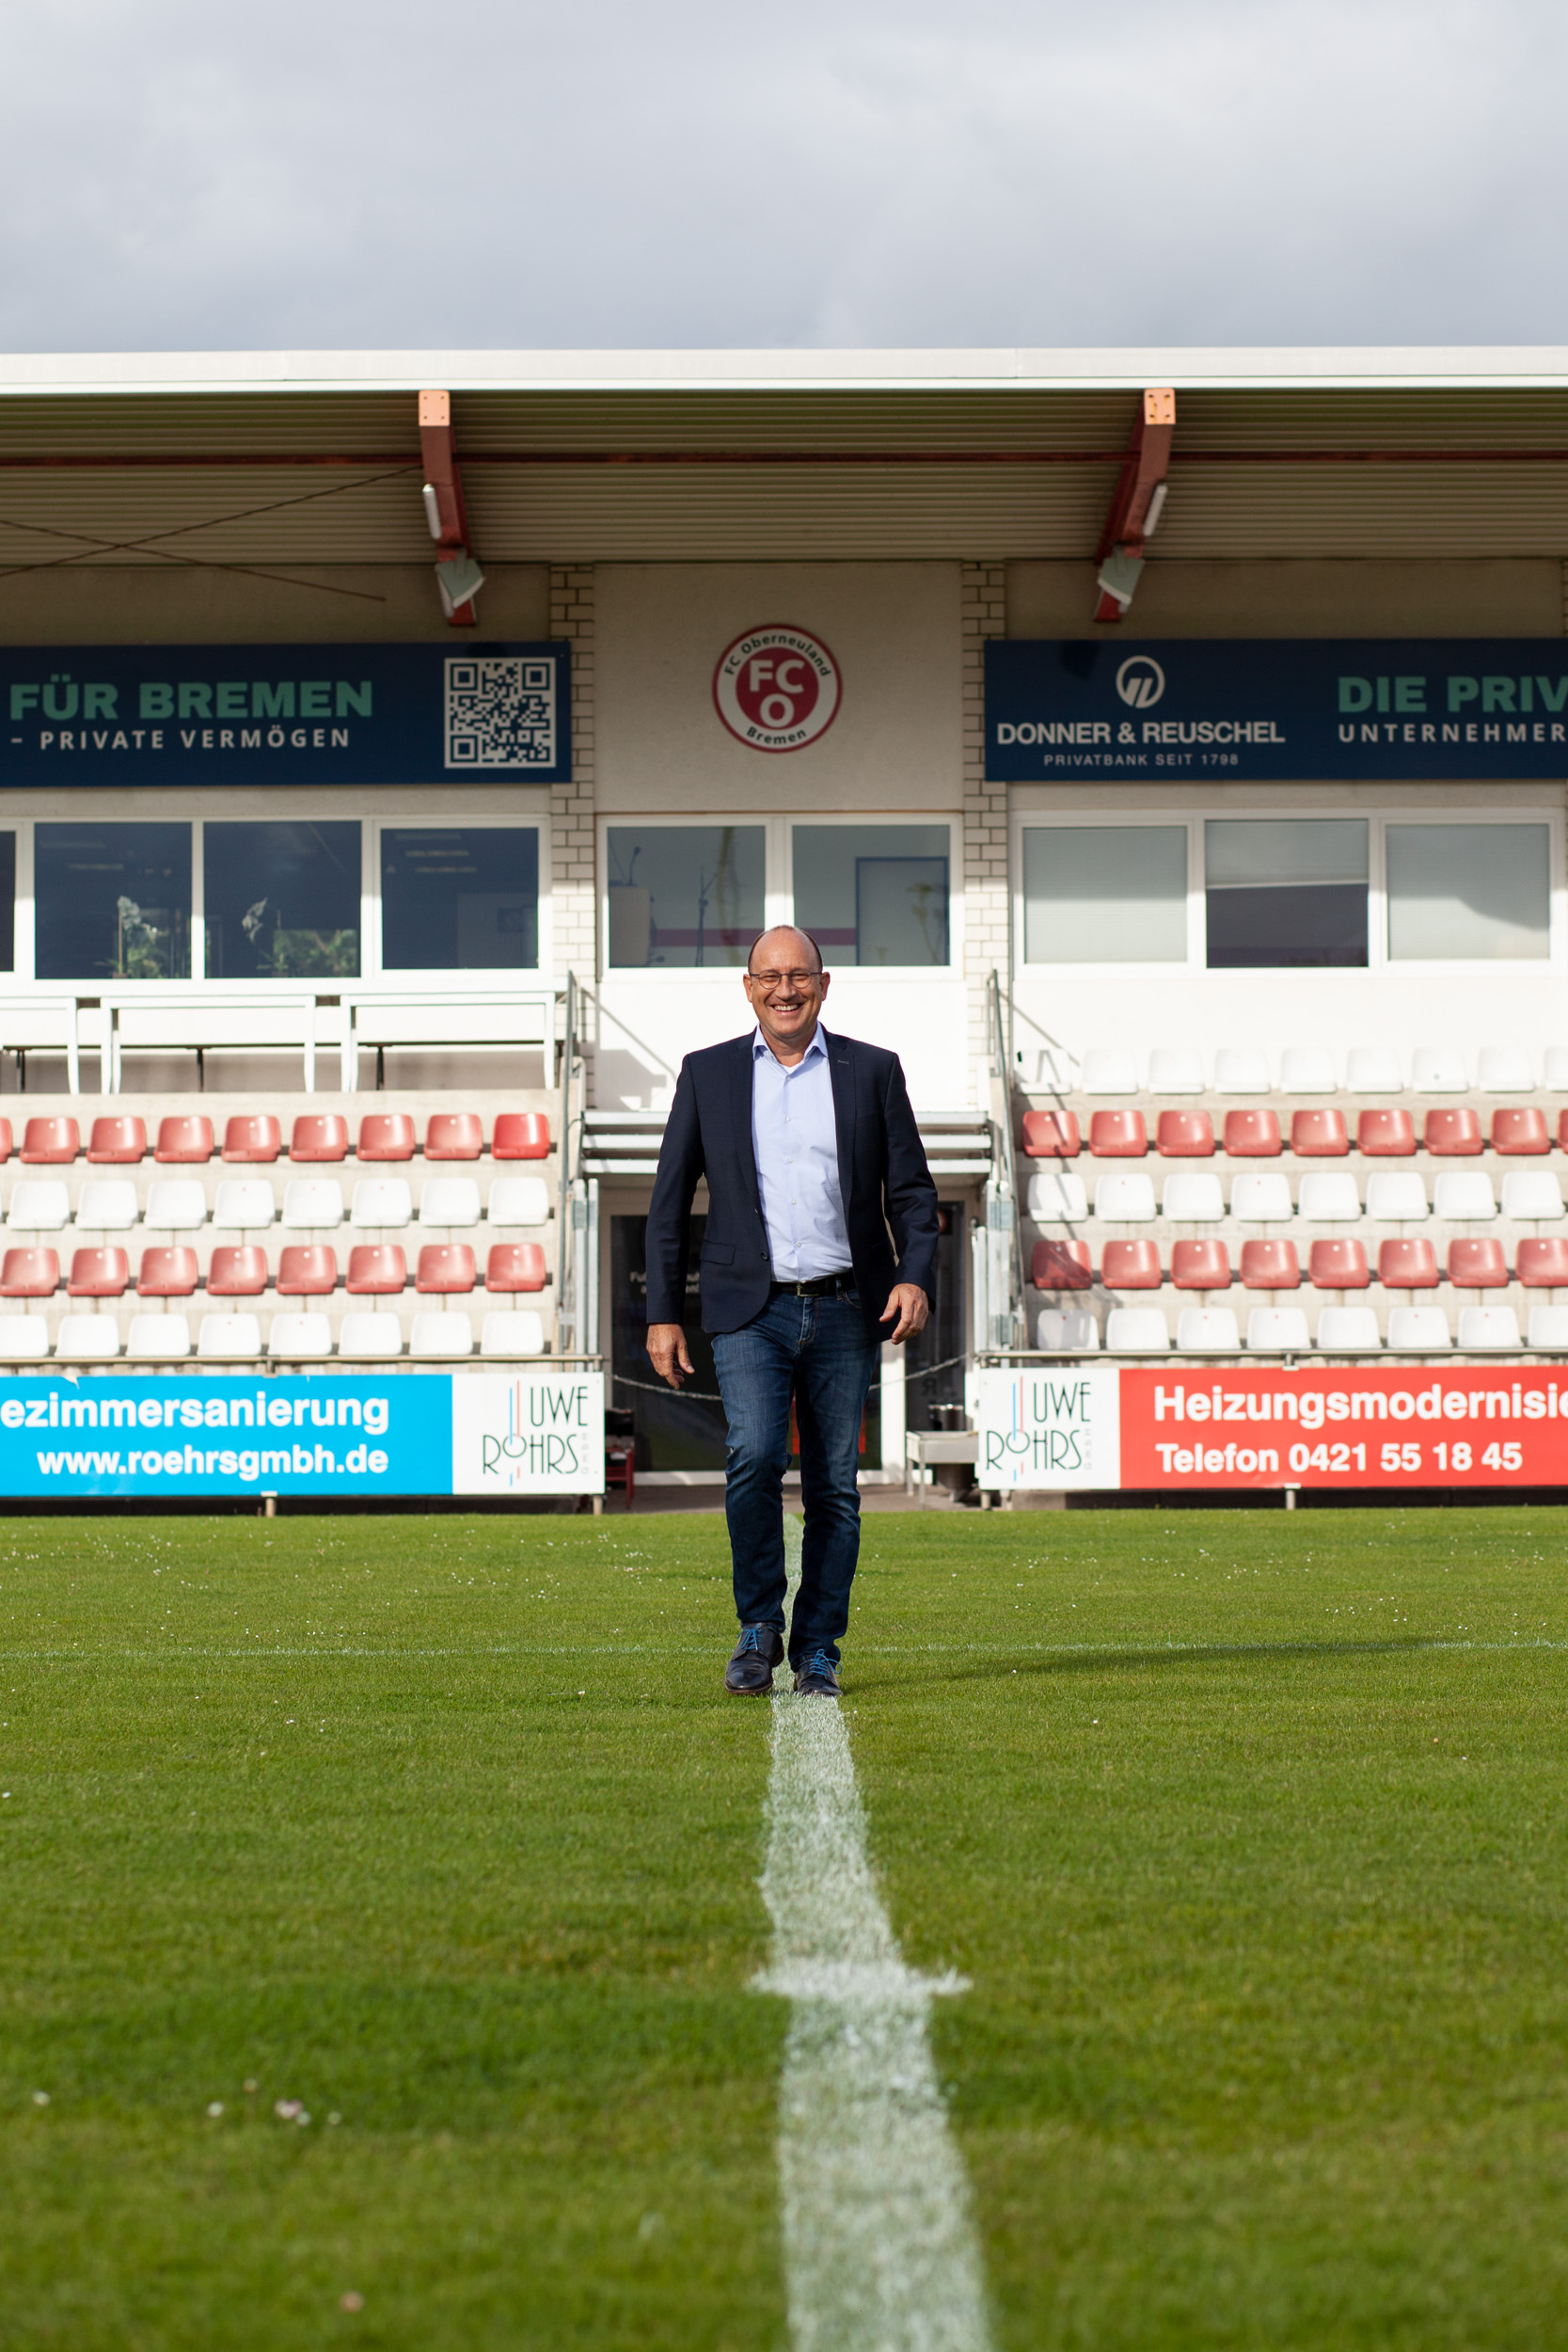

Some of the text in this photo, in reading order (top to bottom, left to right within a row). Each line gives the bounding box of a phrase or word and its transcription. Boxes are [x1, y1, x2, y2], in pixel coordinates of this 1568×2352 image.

[724, 635, 832, 676] FC Oberneuland
[750, 659, 805, 694] FC
[1338, 675, 1568, 713] DIE PRIV
[10, 674, 372, 721] FÜR BREMEN
[759, 693, 795, 728] O
[40, 730, 164, 751] PRIVATE
[181, 724, 349, 750] VERMÖGEN
[746, 726, 807, 744] Bremen
[997, 721, 1286, 745] DONNER & REUSCHEL
[1338, 723, 1566, 743] UNTERNEHMER
[1043, 753, 1240, 767] PRIVATBANK SEIT 1798
[0, 1391, 389, 1436] ezimmersanierung
[530, 1386, 588, 1427] UWE
[1033, 1382, 1091, 1422] UWE
[36, 1443, 389, 1482] www.roehrsgmbh.de
[1154, 1441, 1523, 1473] Telefon 0421 55 18 45
